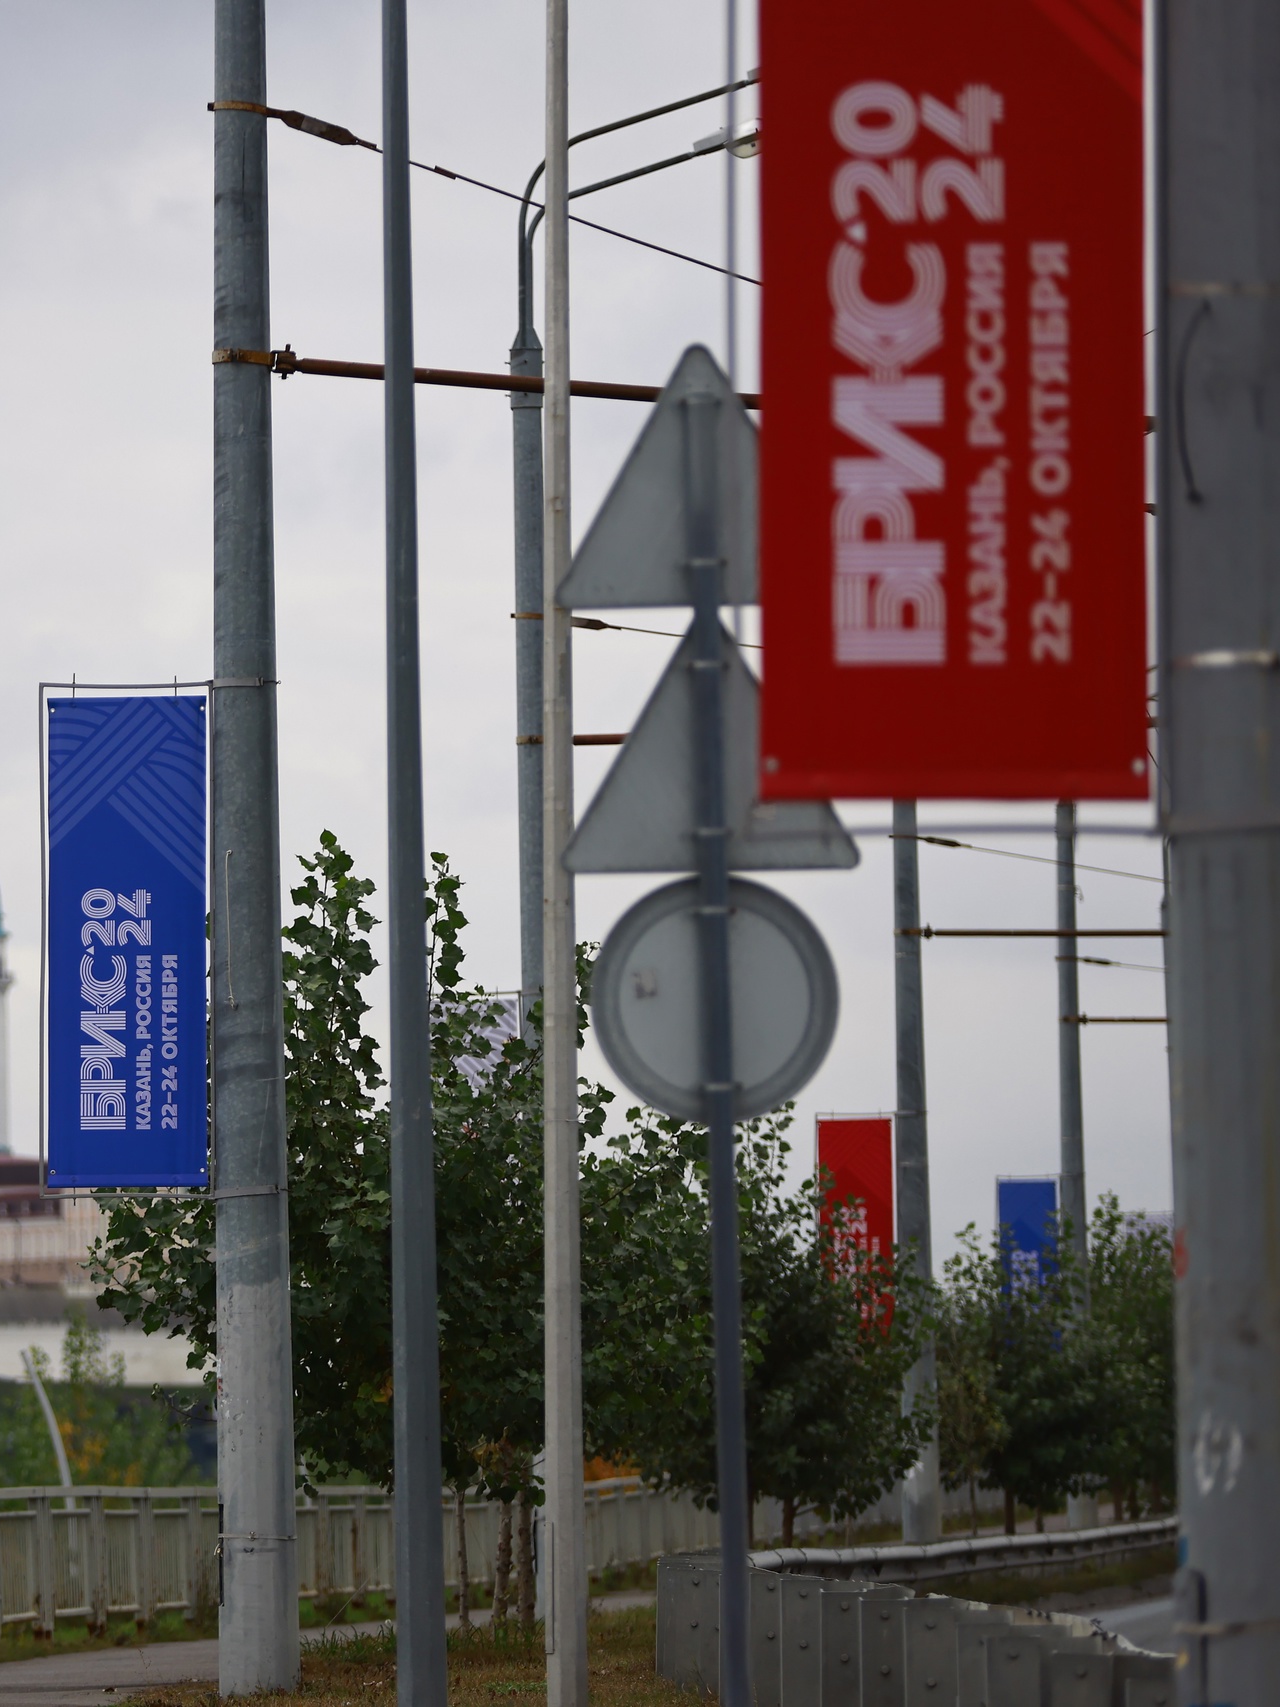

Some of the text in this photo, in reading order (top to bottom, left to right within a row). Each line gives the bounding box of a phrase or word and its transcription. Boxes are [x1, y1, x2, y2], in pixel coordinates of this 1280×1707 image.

[919, 82, 1006, 224] 24
[827, 80, 947, 666] БРИКС 20
[965, 242, 1011, 665] КАЗАНЬ, РОССИЯ
[1029, 240, 1071, 496] ОКТЯБРЯ
[80, 888, 127, 1130] БРИКС 20
[117, 889, 152, 946] 24
[161, 954, 178, 1060] ОКТЯБРЯ
[135, 954, 154, 1130] КАЗАНЬ, РОССИЯ
